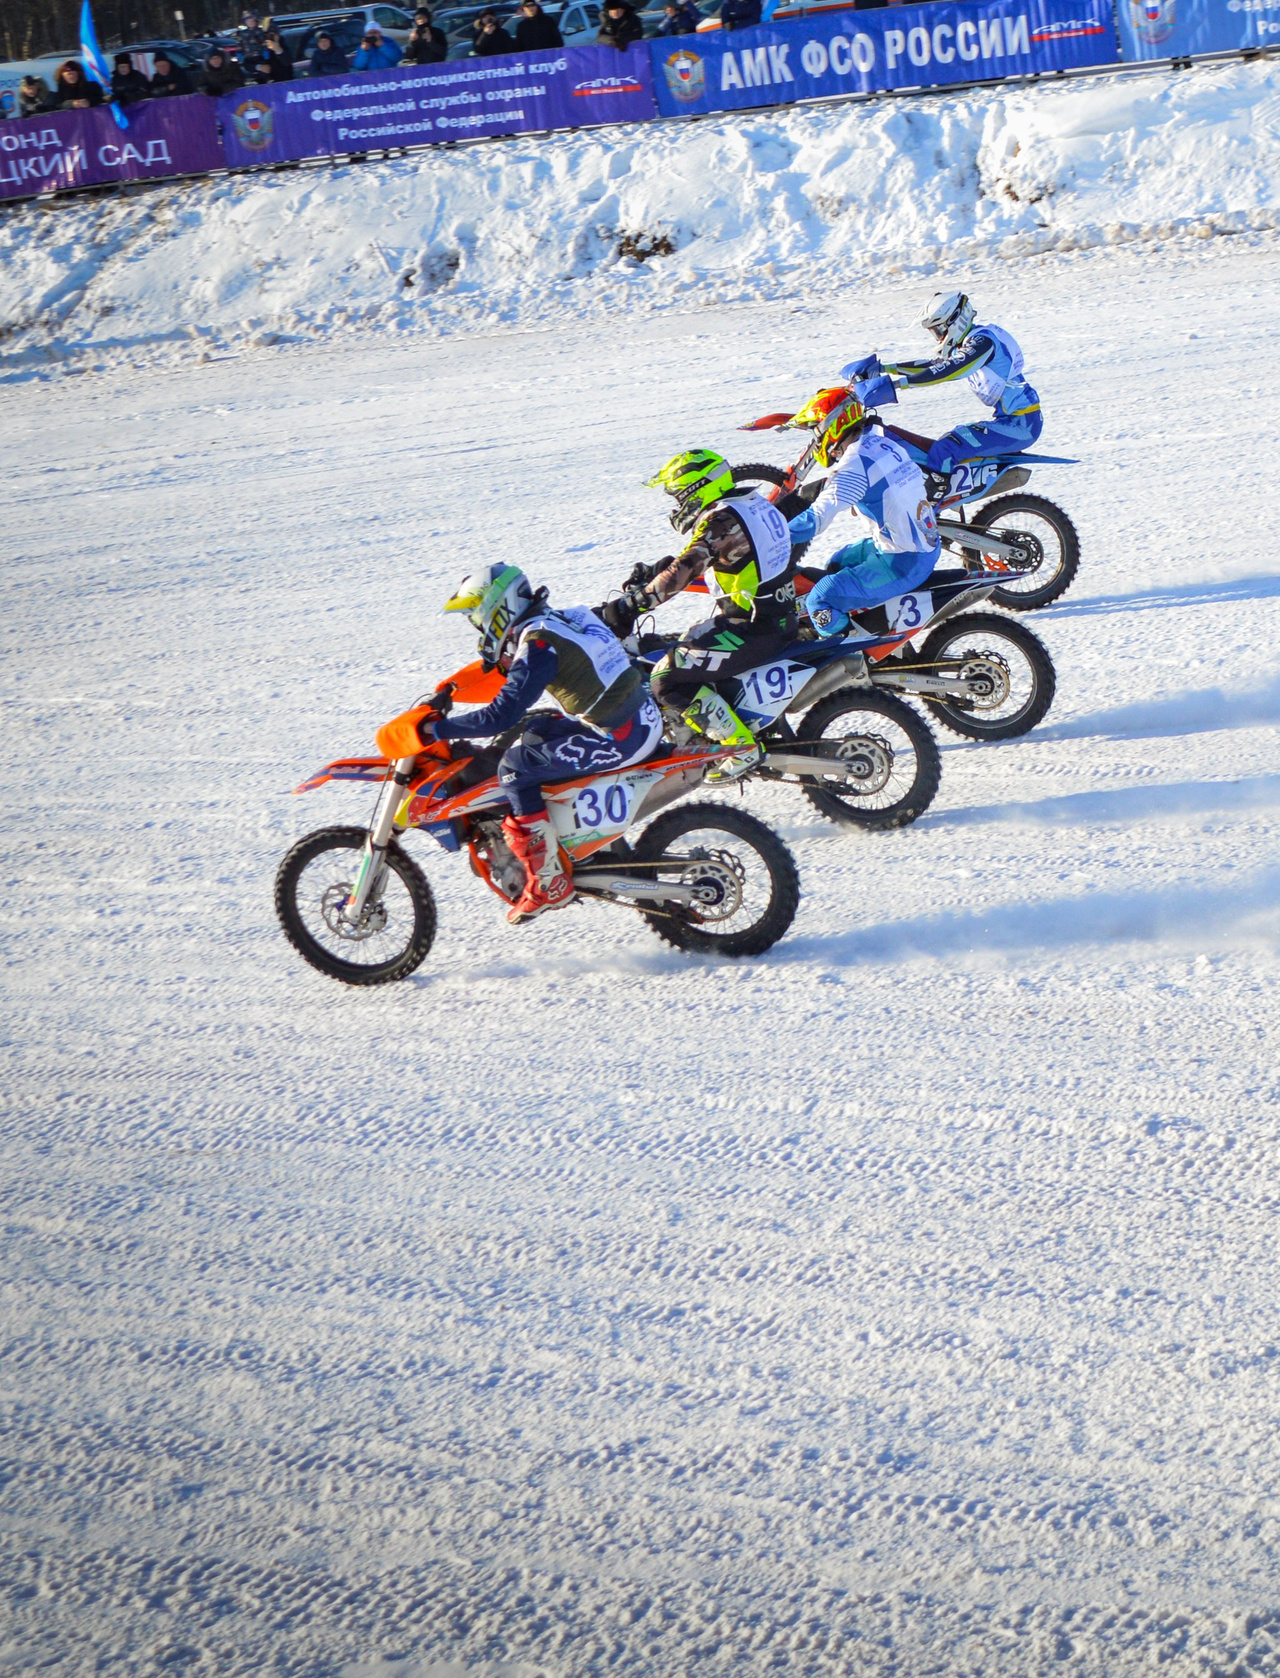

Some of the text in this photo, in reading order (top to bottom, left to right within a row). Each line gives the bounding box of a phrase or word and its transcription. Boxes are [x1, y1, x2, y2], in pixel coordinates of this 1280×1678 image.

[721, 15, 1031, 91] АМК ФСО РОССИИ
[285, 58, 568, 104] Автомобильно-мотоциклетный клуб
[310, 85, 546, 122] Федеральной службы охраны
[0, 129, 63, 151] онд
[338, 109, 524, 140] Российской Федерации
[98, 139, 172, 167] САД
[880, 442, 903, 463] 3
[679, 478, 707, 501] SCOTT
[762, 509, 786, 542] 19
[900, 594, 921, 627] 3
[746, 666, 787, 705] 19
[577, 785, 628, 827] 30
